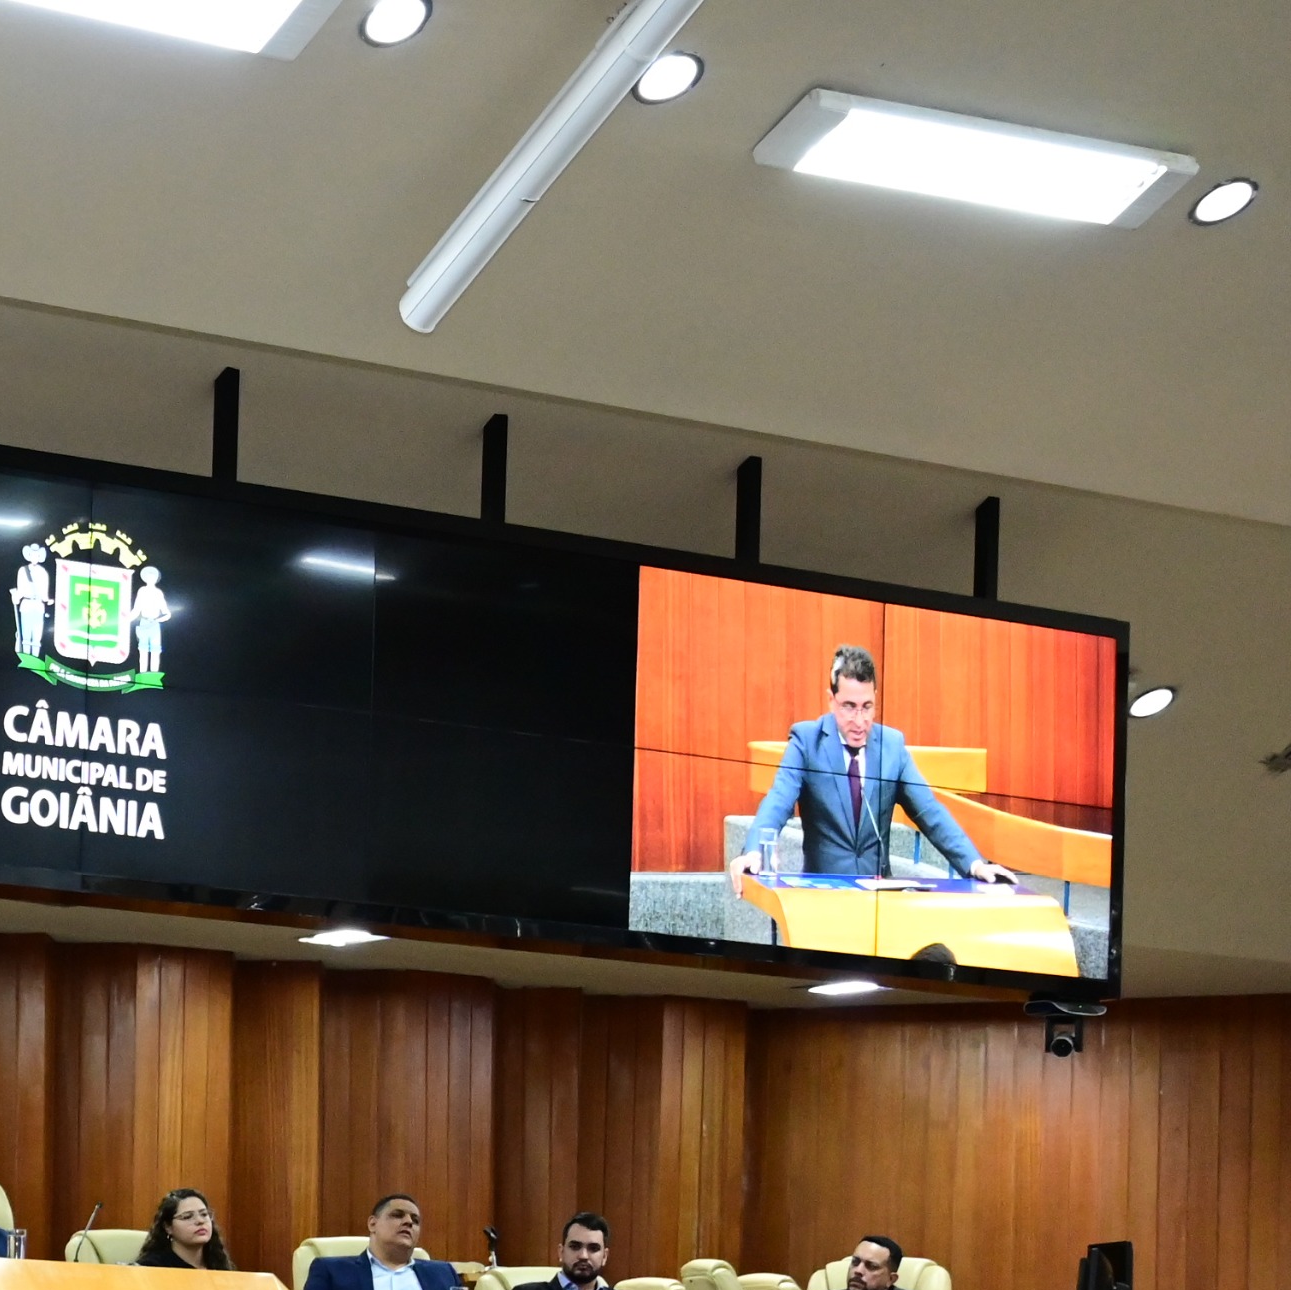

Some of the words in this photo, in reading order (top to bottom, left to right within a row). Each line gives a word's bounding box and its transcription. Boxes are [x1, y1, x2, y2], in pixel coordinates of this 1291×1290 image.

[3, 699, 167, 760] CÂMARA
[2, 751, 133, 790] MUNICIPAL
[135, 767, 167, 794] DE
[1, 786, 165, 840] GOIÂNIA
